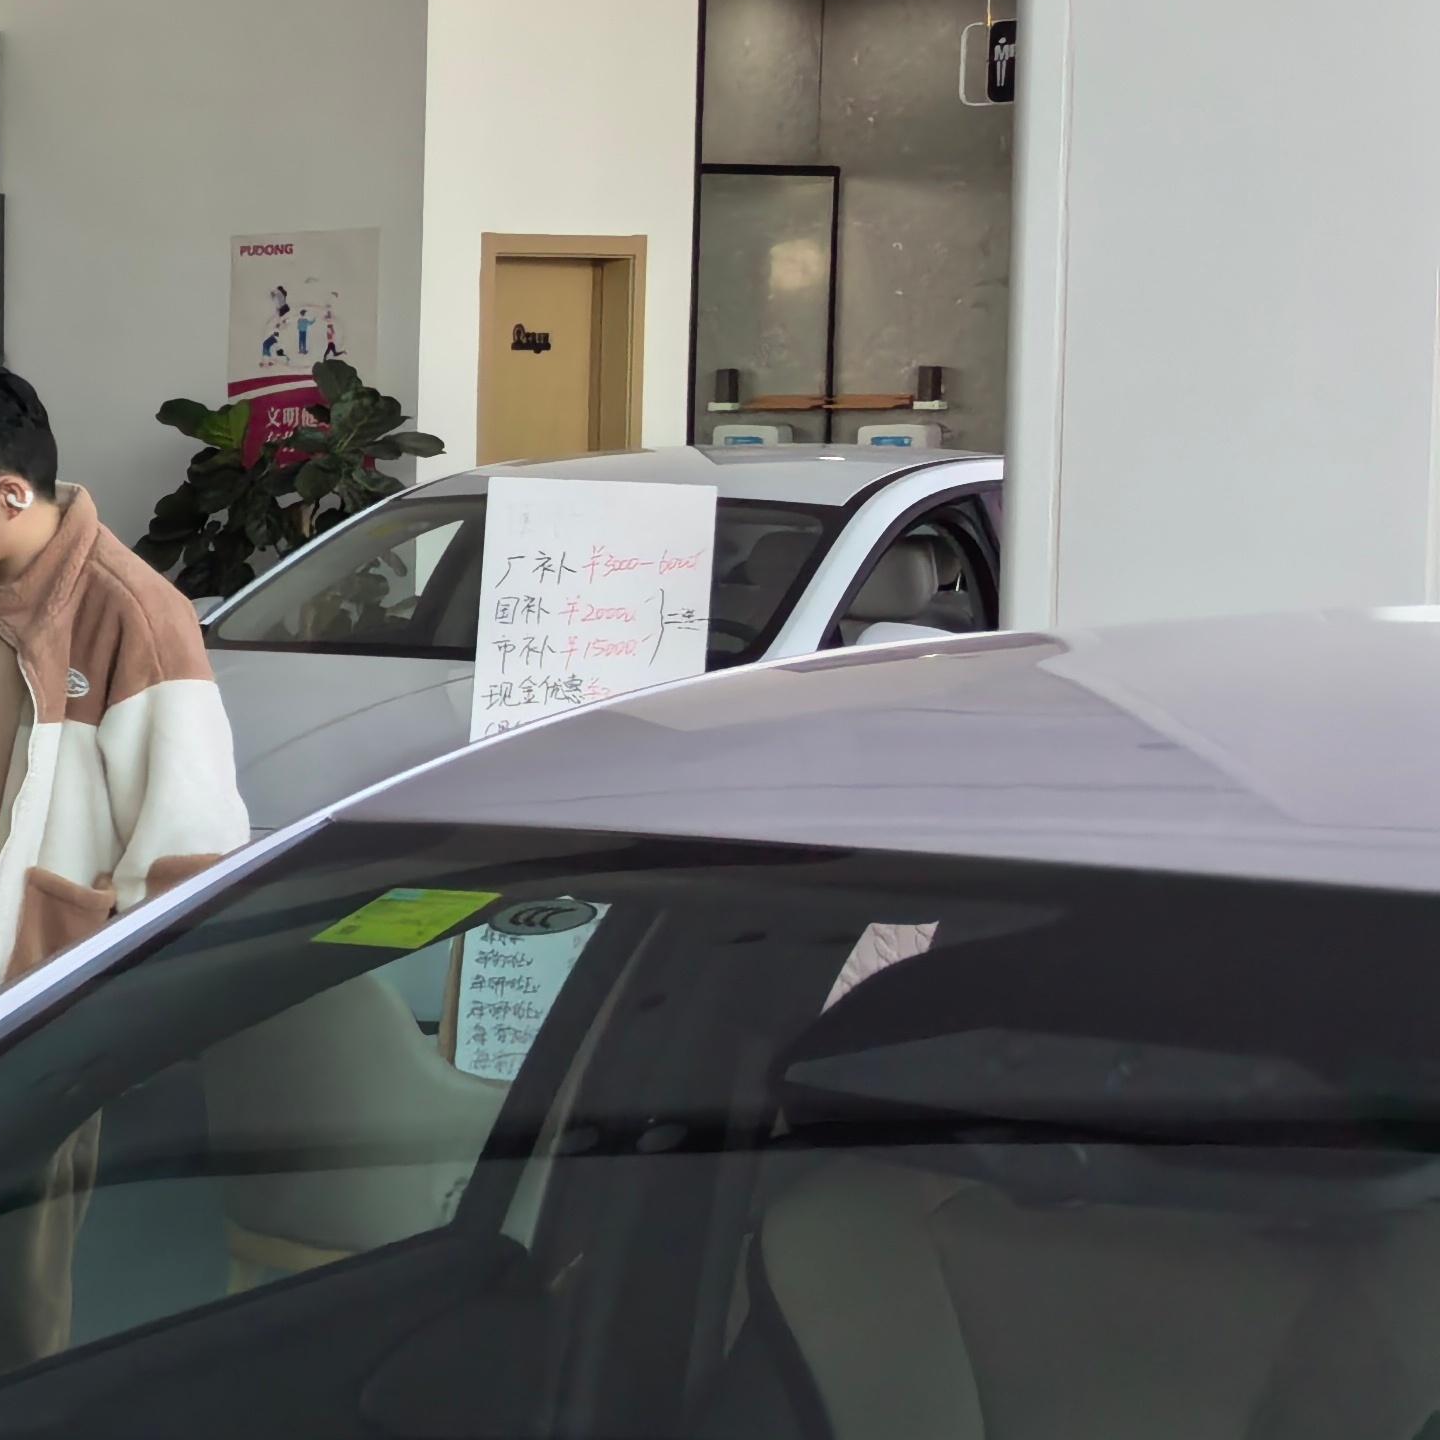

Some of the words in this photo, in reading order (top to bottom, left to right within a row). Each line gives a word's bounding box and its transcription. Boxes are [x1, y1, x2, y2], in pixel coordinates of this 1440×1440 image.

[239, 243, 294, 257] PUDONG
[494, 549, 578, 589] 厂补
[495, 594, 550, 625] 国补
[492, 634, 556, 675] 市补
[480, 673, 585, 711] 现金优惠
